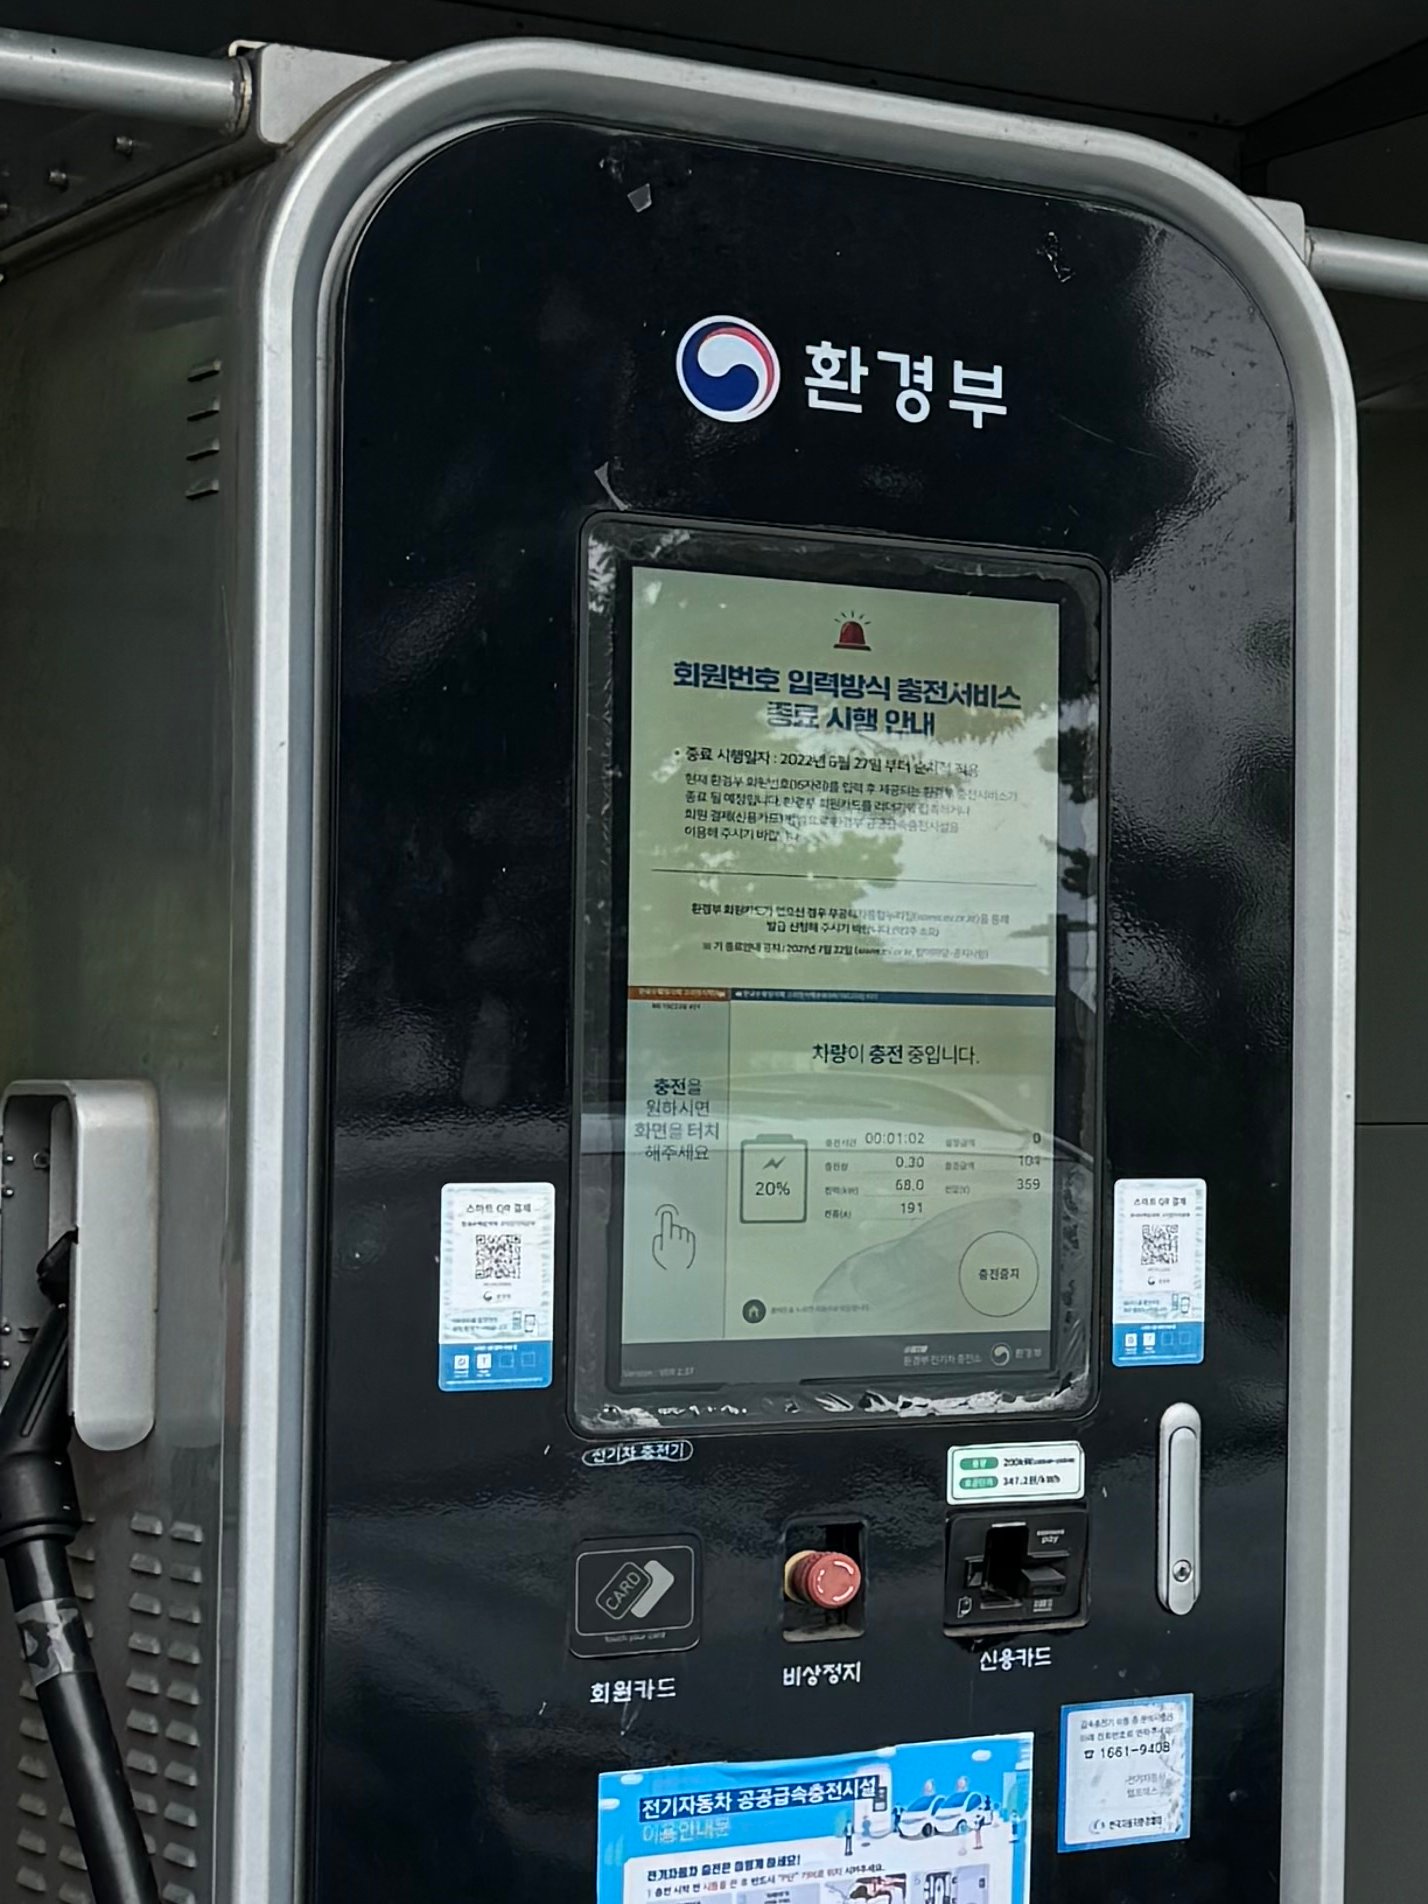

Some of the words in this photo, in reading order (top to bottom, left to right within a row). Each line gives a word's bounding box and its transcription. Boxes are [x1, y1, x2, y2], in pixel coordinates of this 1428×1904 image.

[803, 340, 1008, 429] 환경부
[673, 660, 781, 694] 회원번호
[787, 668, 891, 702] 입력방식
[896, 676, 1022, 711] 충전서비스
[766, 700, 819, 730] 종료
[825, 703, 879, 734] 시행
[885, 708, 936, 737] 안내
[686, 746, 713, 762] 종료
[717, 747, 771, 765] 시행일자
[780, 752, 826, 769] 2022년
[885, 757, 911, 774] 부터
[811, 1042, 865, 1064] 차량이
[868, 1043, 903, 1065] 충전
[907, 1044, 981, 1066] 중입니다.
[653, 1076, 703, 1097] 충전을
[645, 1099, 711, 1118] 원하시면
[633, 1121, 684, 1141] 화면을
[686, 1120, 720, 1141] 터치
[864, 1132, 925, 1145] 00:01:02
[1032, 1132, 1042, 1144] 0
[644, 1142, 710, 1163] 해주세요
[895, 1155, 925, 1169] 0.30
[754, 1181, 791, 1197] 20%
[895, 1178, 925, 1191] 68.0
[1016, 1178, 1041, 1191] 359
[900, 1202, 923, 1214] 191
[605, 1571, 641, 1611] CARD
[979, 1646, 1052, 1672] 신용카드
[783, 1660, 862, 1687] 비상정지
[589, 1677, 676, 1704] 회원카드
[641, 1793, 732, 1819] 전기자동차
[737, 1776, 877, 1811] 공공급속충전시설
